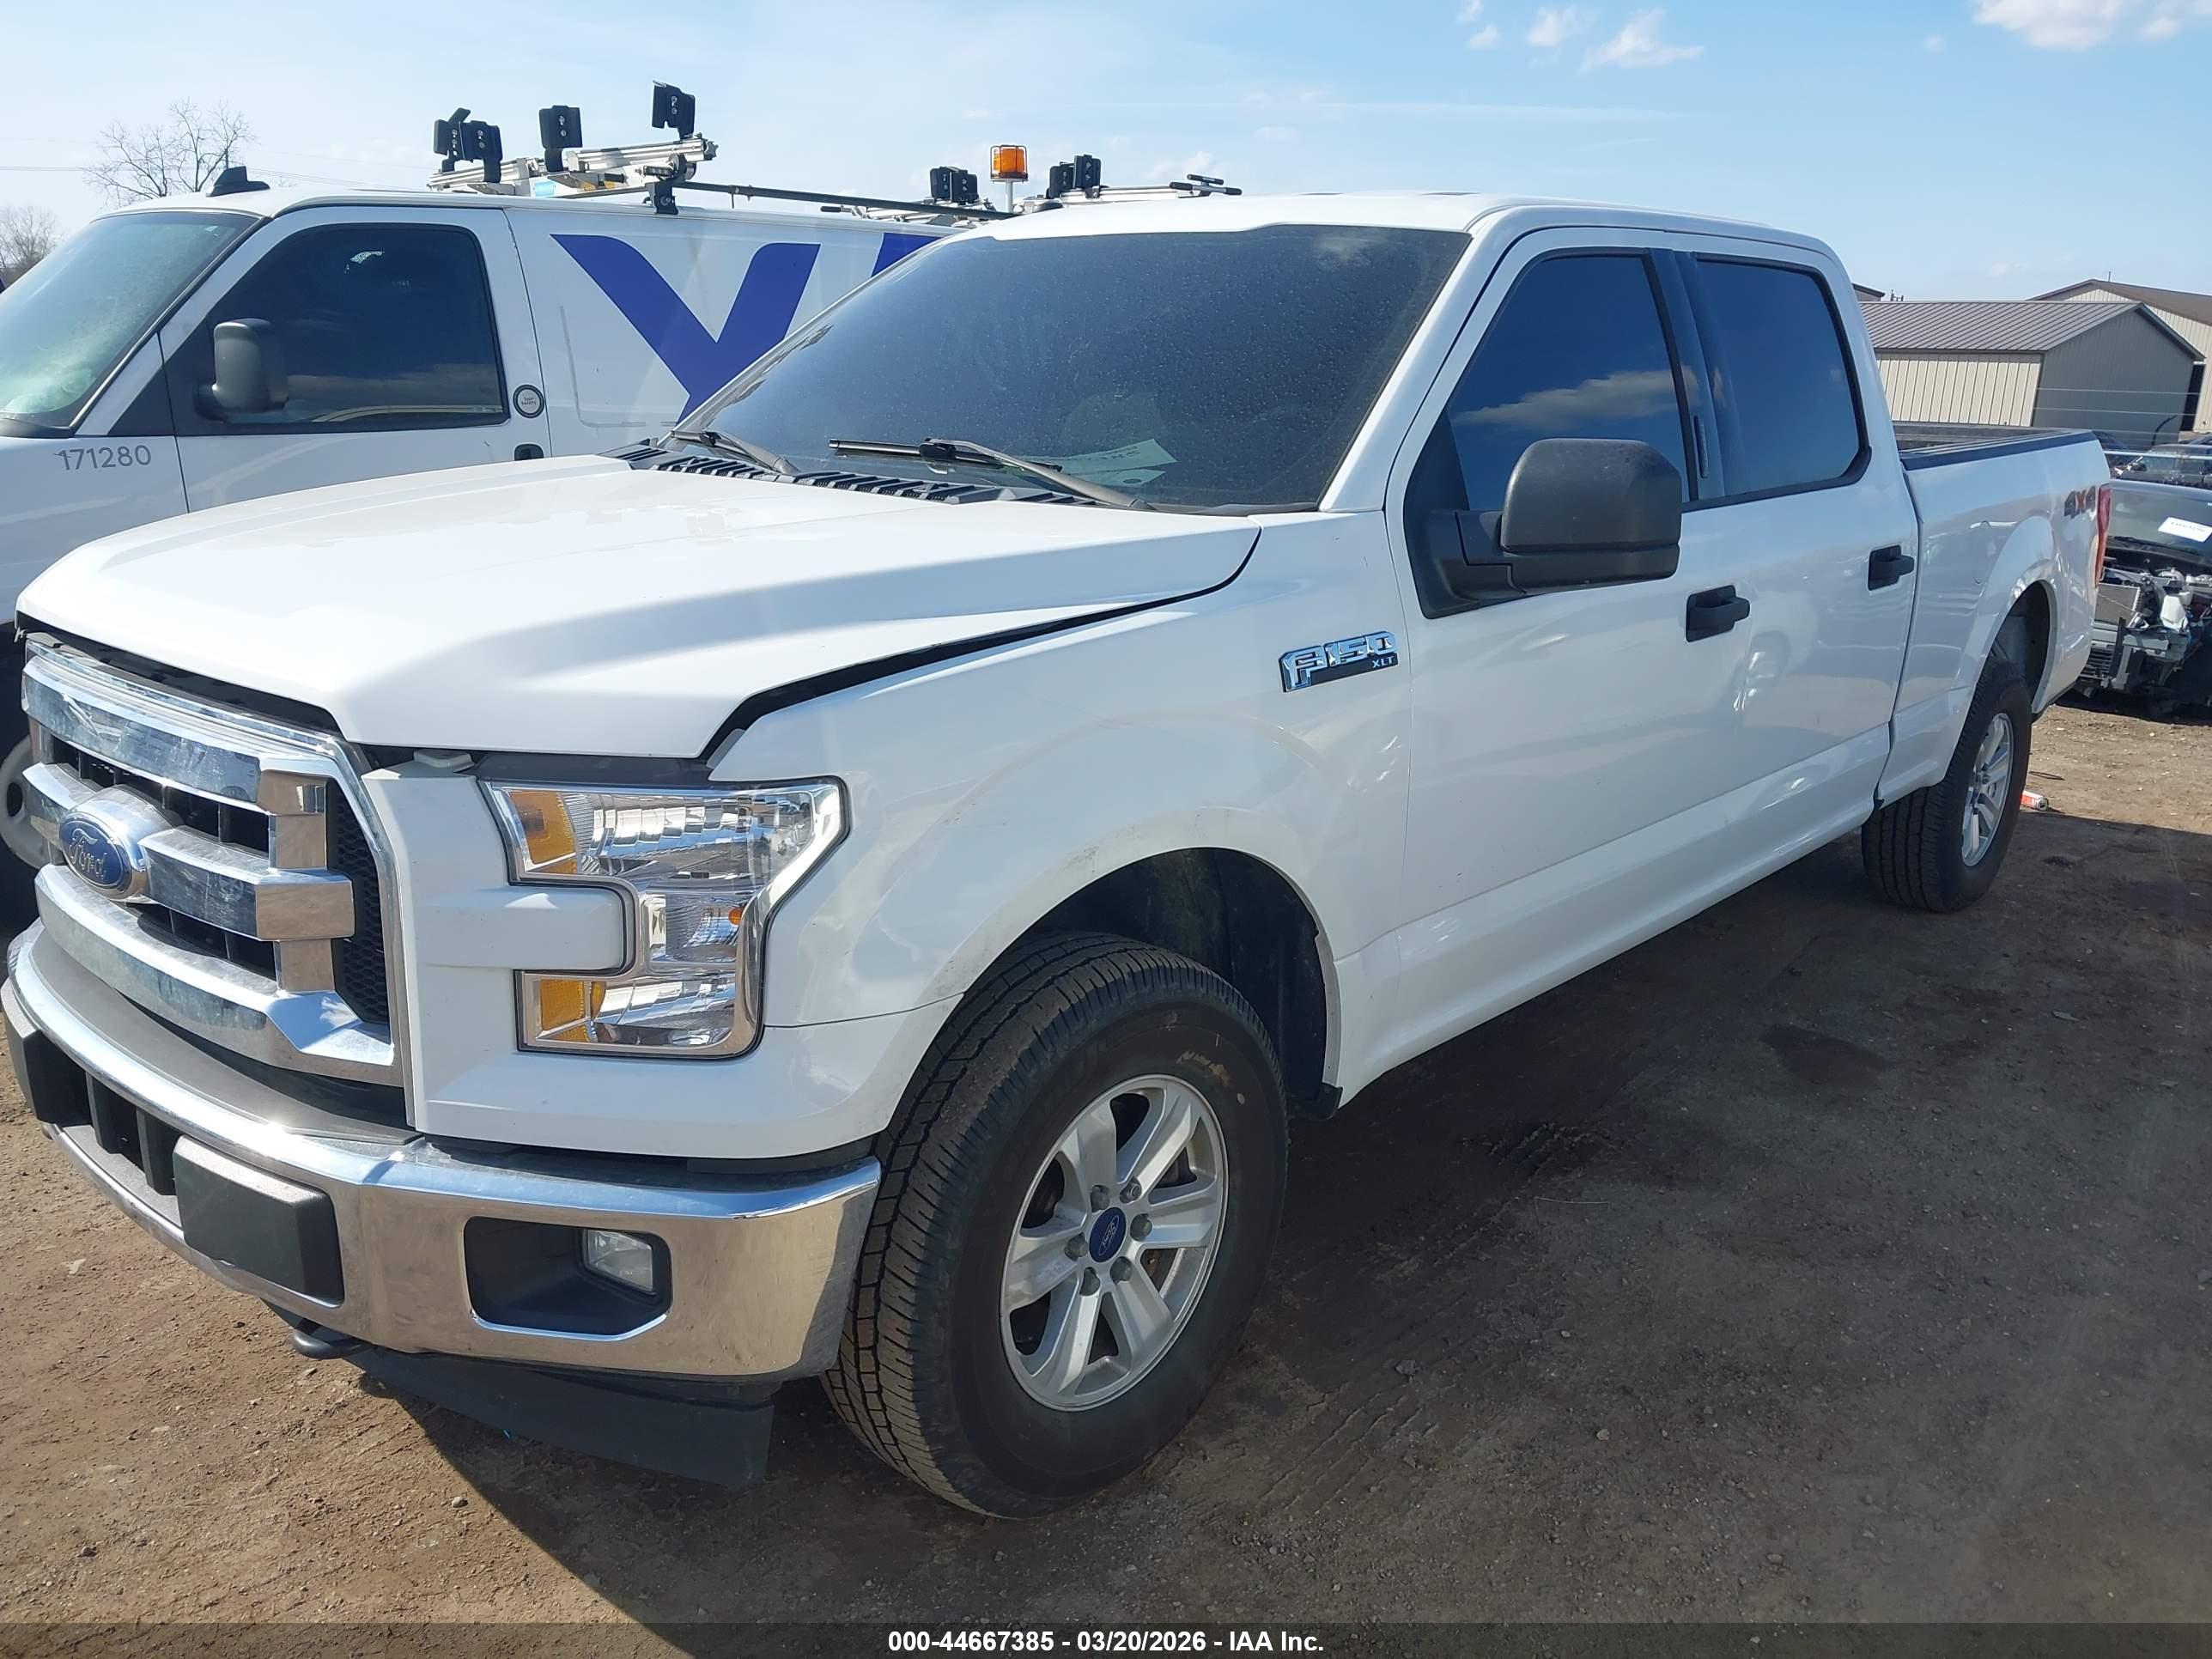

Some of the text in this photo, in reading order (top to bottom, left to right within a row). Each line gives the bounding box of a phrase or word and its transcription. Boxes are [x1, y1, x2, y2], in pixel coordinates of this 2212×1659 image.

[53, 445, 151, 471] 171280
[1372, 656, 1394, 668] XLT
[70, 828, 107, 879] Ford
